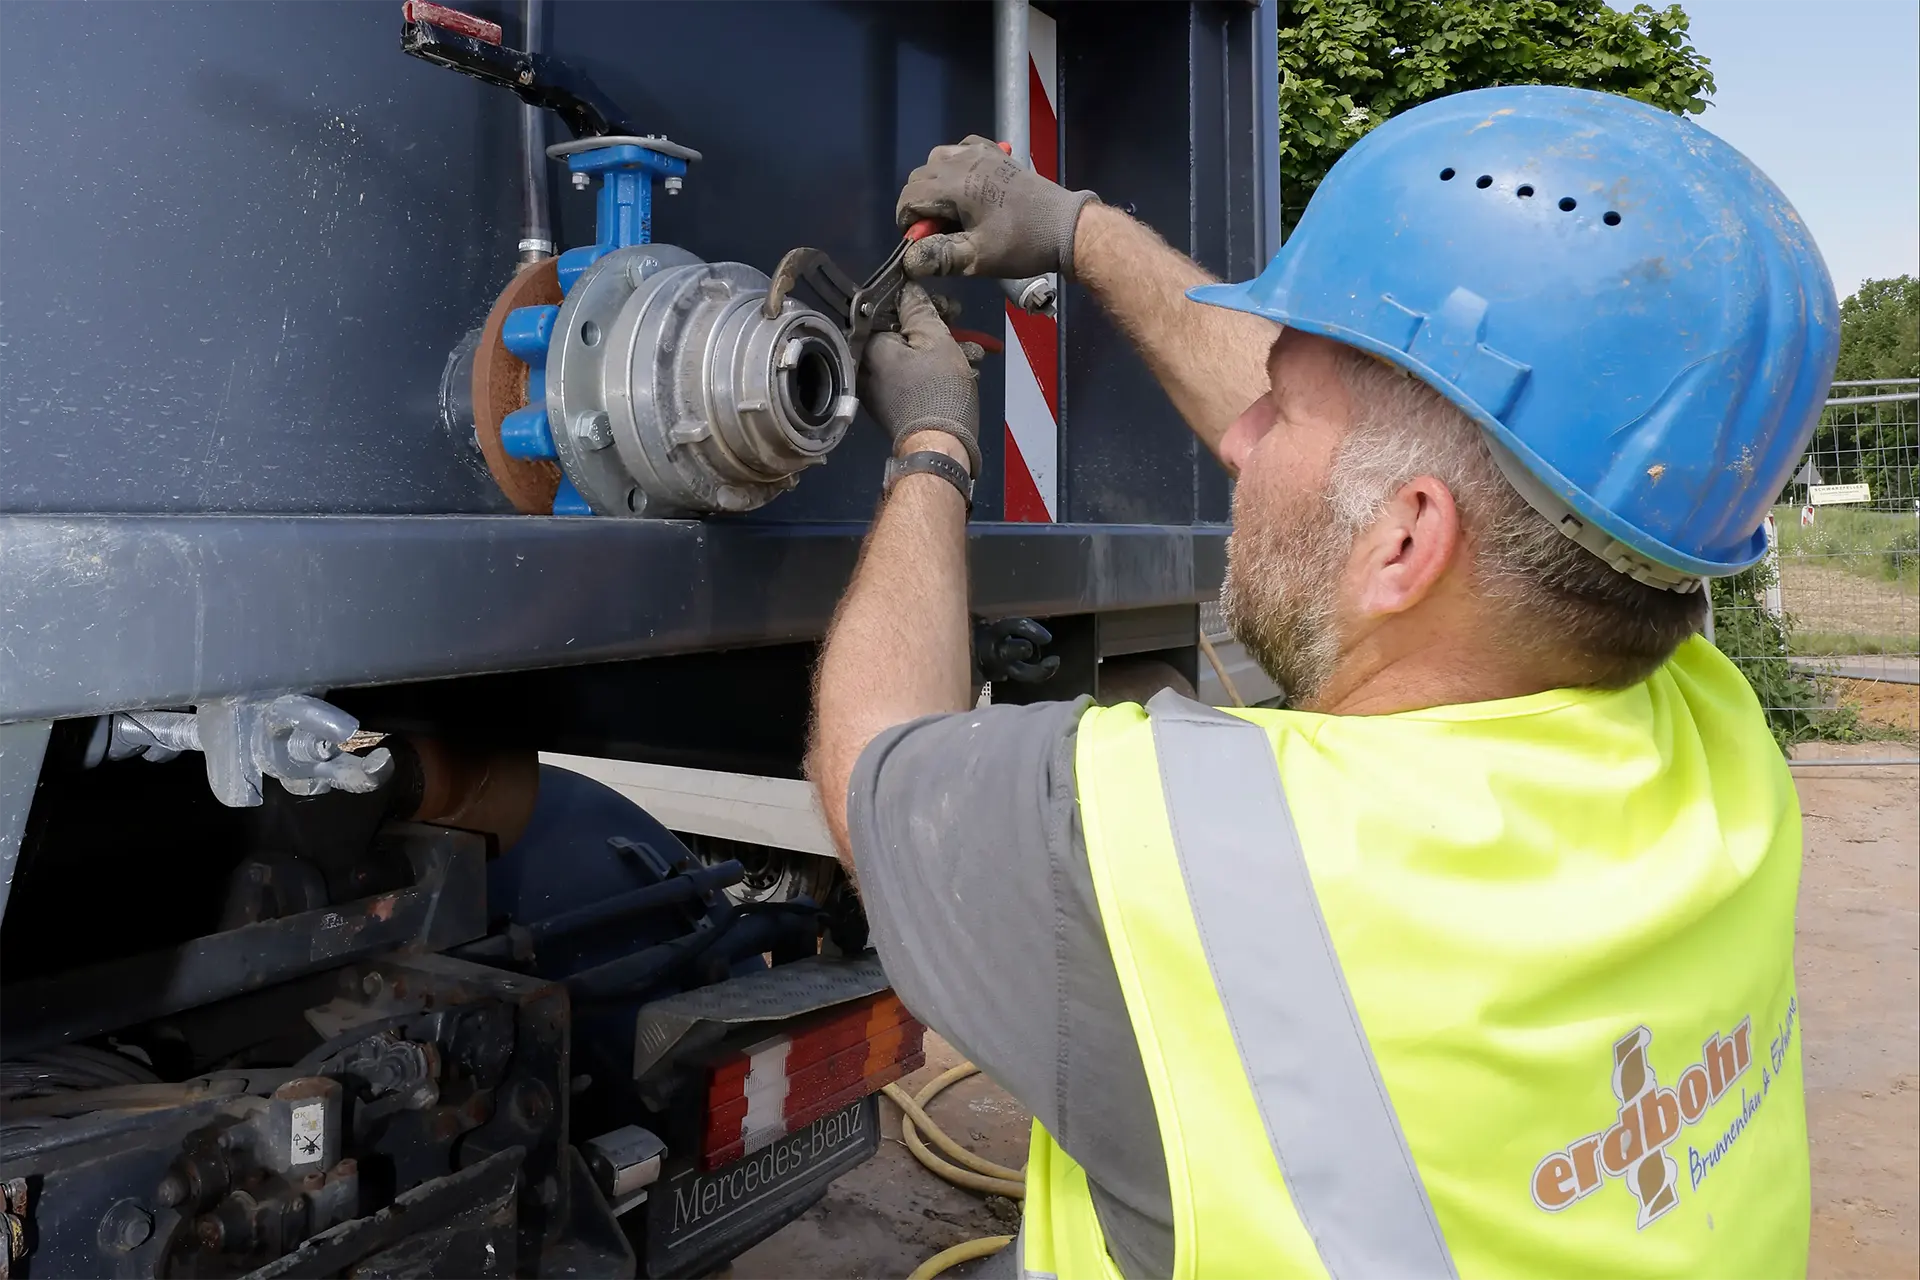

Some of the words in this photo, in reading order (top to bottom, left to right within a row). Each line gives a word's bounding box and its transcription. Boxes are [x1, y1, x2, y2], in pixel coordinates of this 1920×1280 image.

[670, 1103, 862, 1234] Mercedes-Benz
[1531, 1016, 1752, 1211] erdbohr
[1689, 1089, 1762, 1191] Brunnenbau
[1762, 1067, 1771, 1095] &
